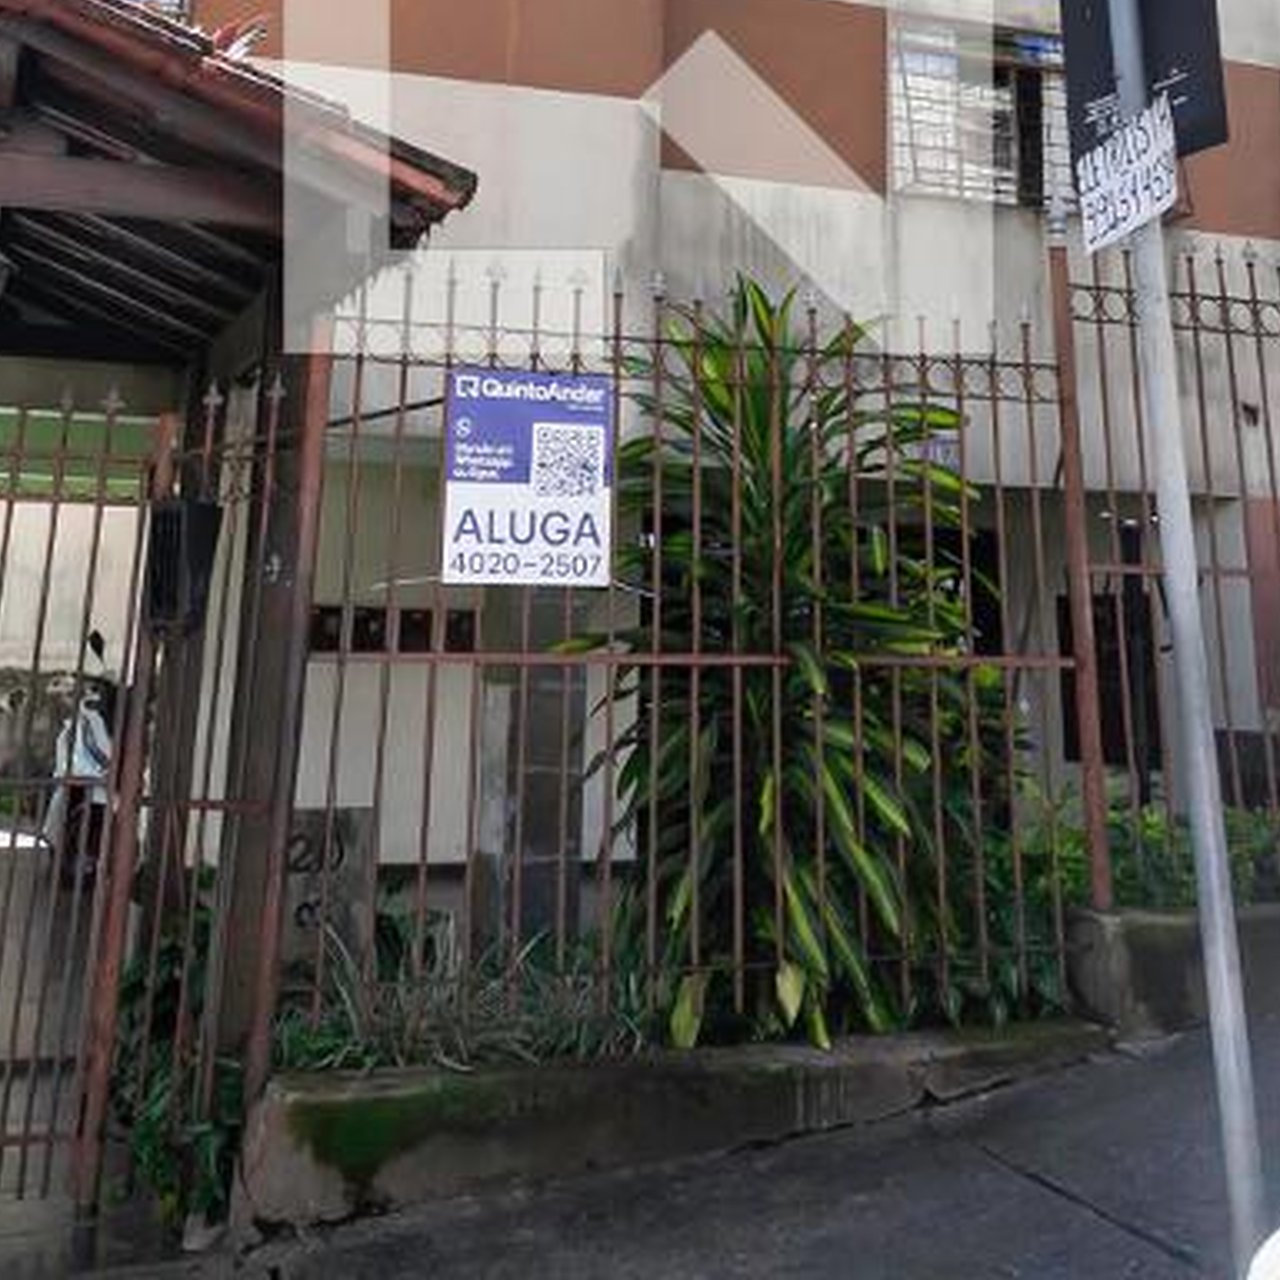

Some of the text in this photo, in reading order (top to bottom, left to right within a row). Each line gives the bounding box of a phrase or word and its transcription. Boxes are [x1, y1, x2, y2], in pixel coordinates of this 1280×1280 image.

[482, 378, 605, 403] QuintoAndar
[453, 509, 601, 546] ALUGA
[451, 552, 602, 577] 4020-2507
